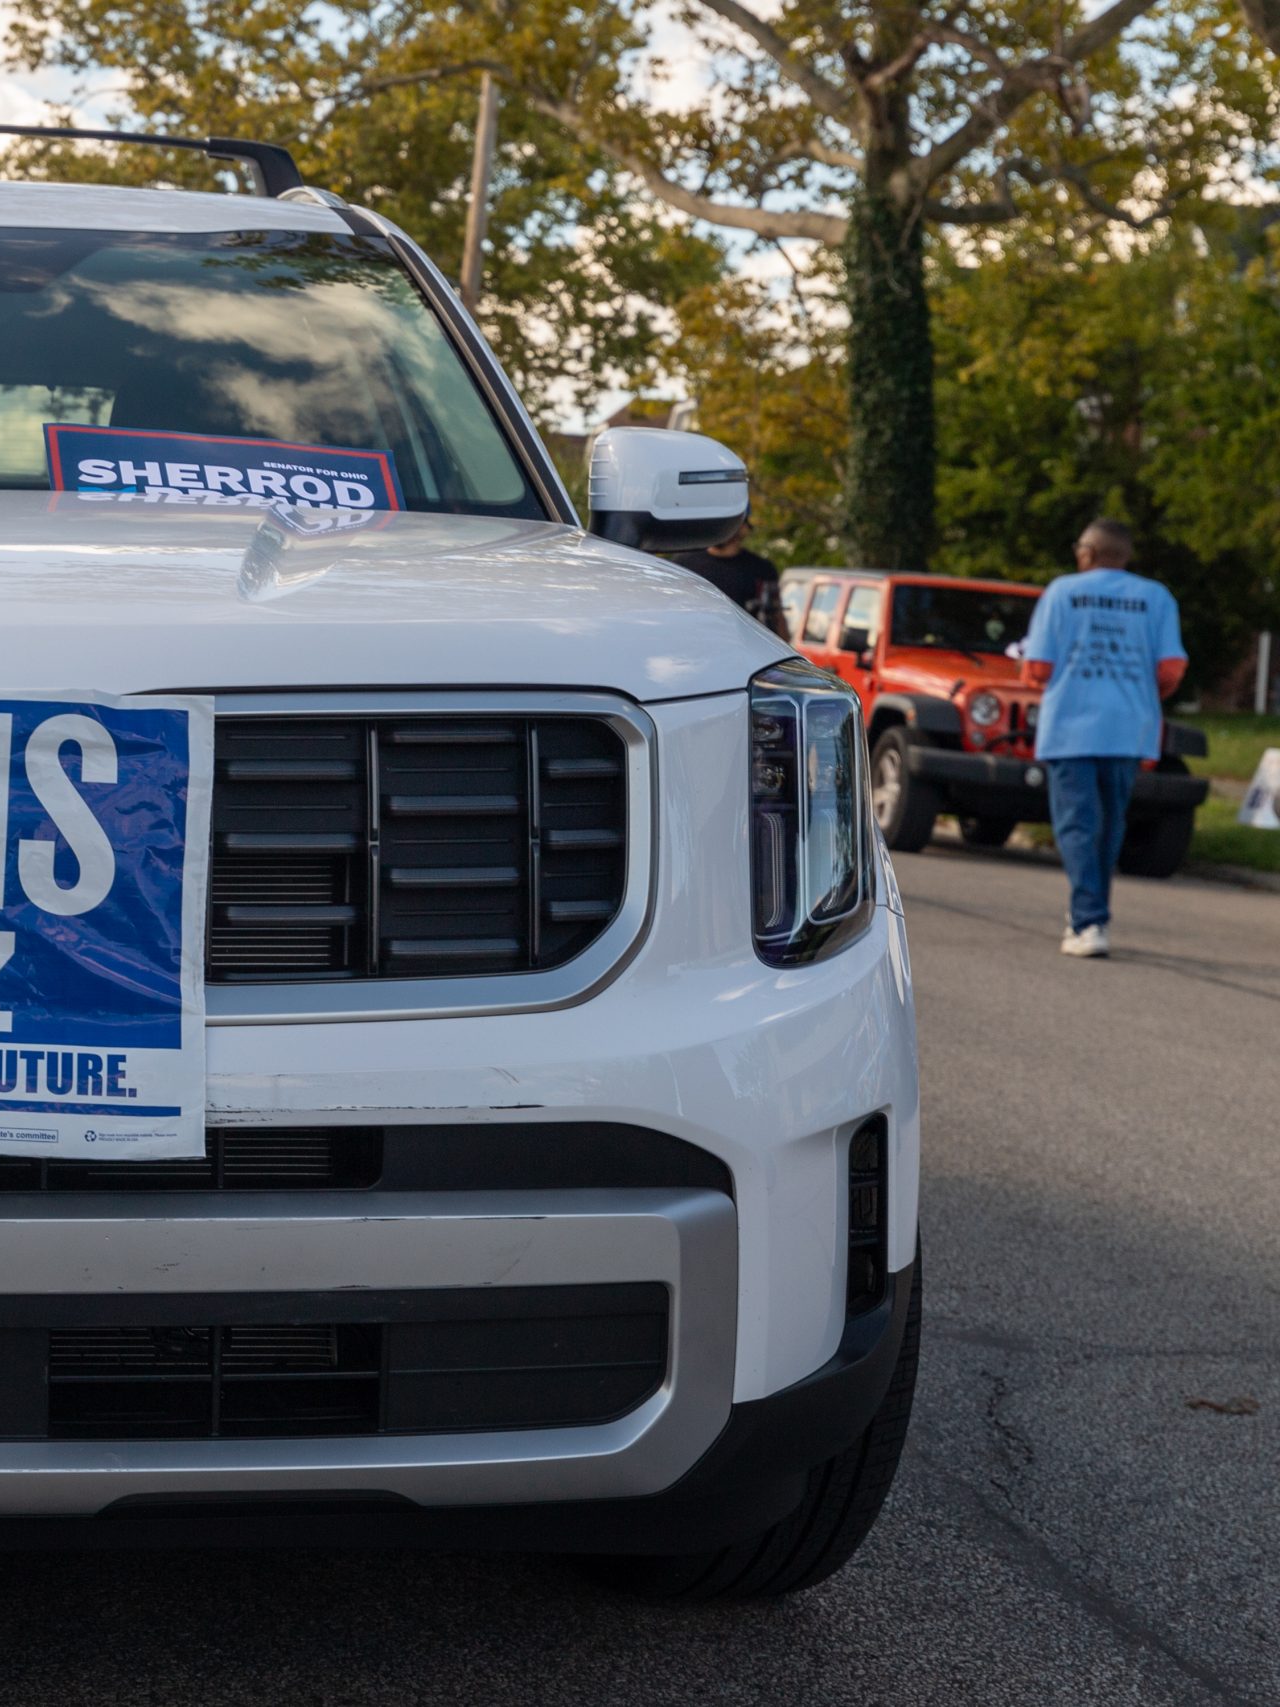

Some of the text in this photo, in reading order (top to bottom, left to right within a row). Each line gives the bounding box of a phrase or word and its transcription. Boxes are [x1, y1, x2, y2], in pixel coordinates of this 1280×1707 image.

[263, 461, 368, 481] SENATOR FOR OHIO
[78, 458, 375, 508] SHERROD
[16, 1131, 56, 1141] committee
